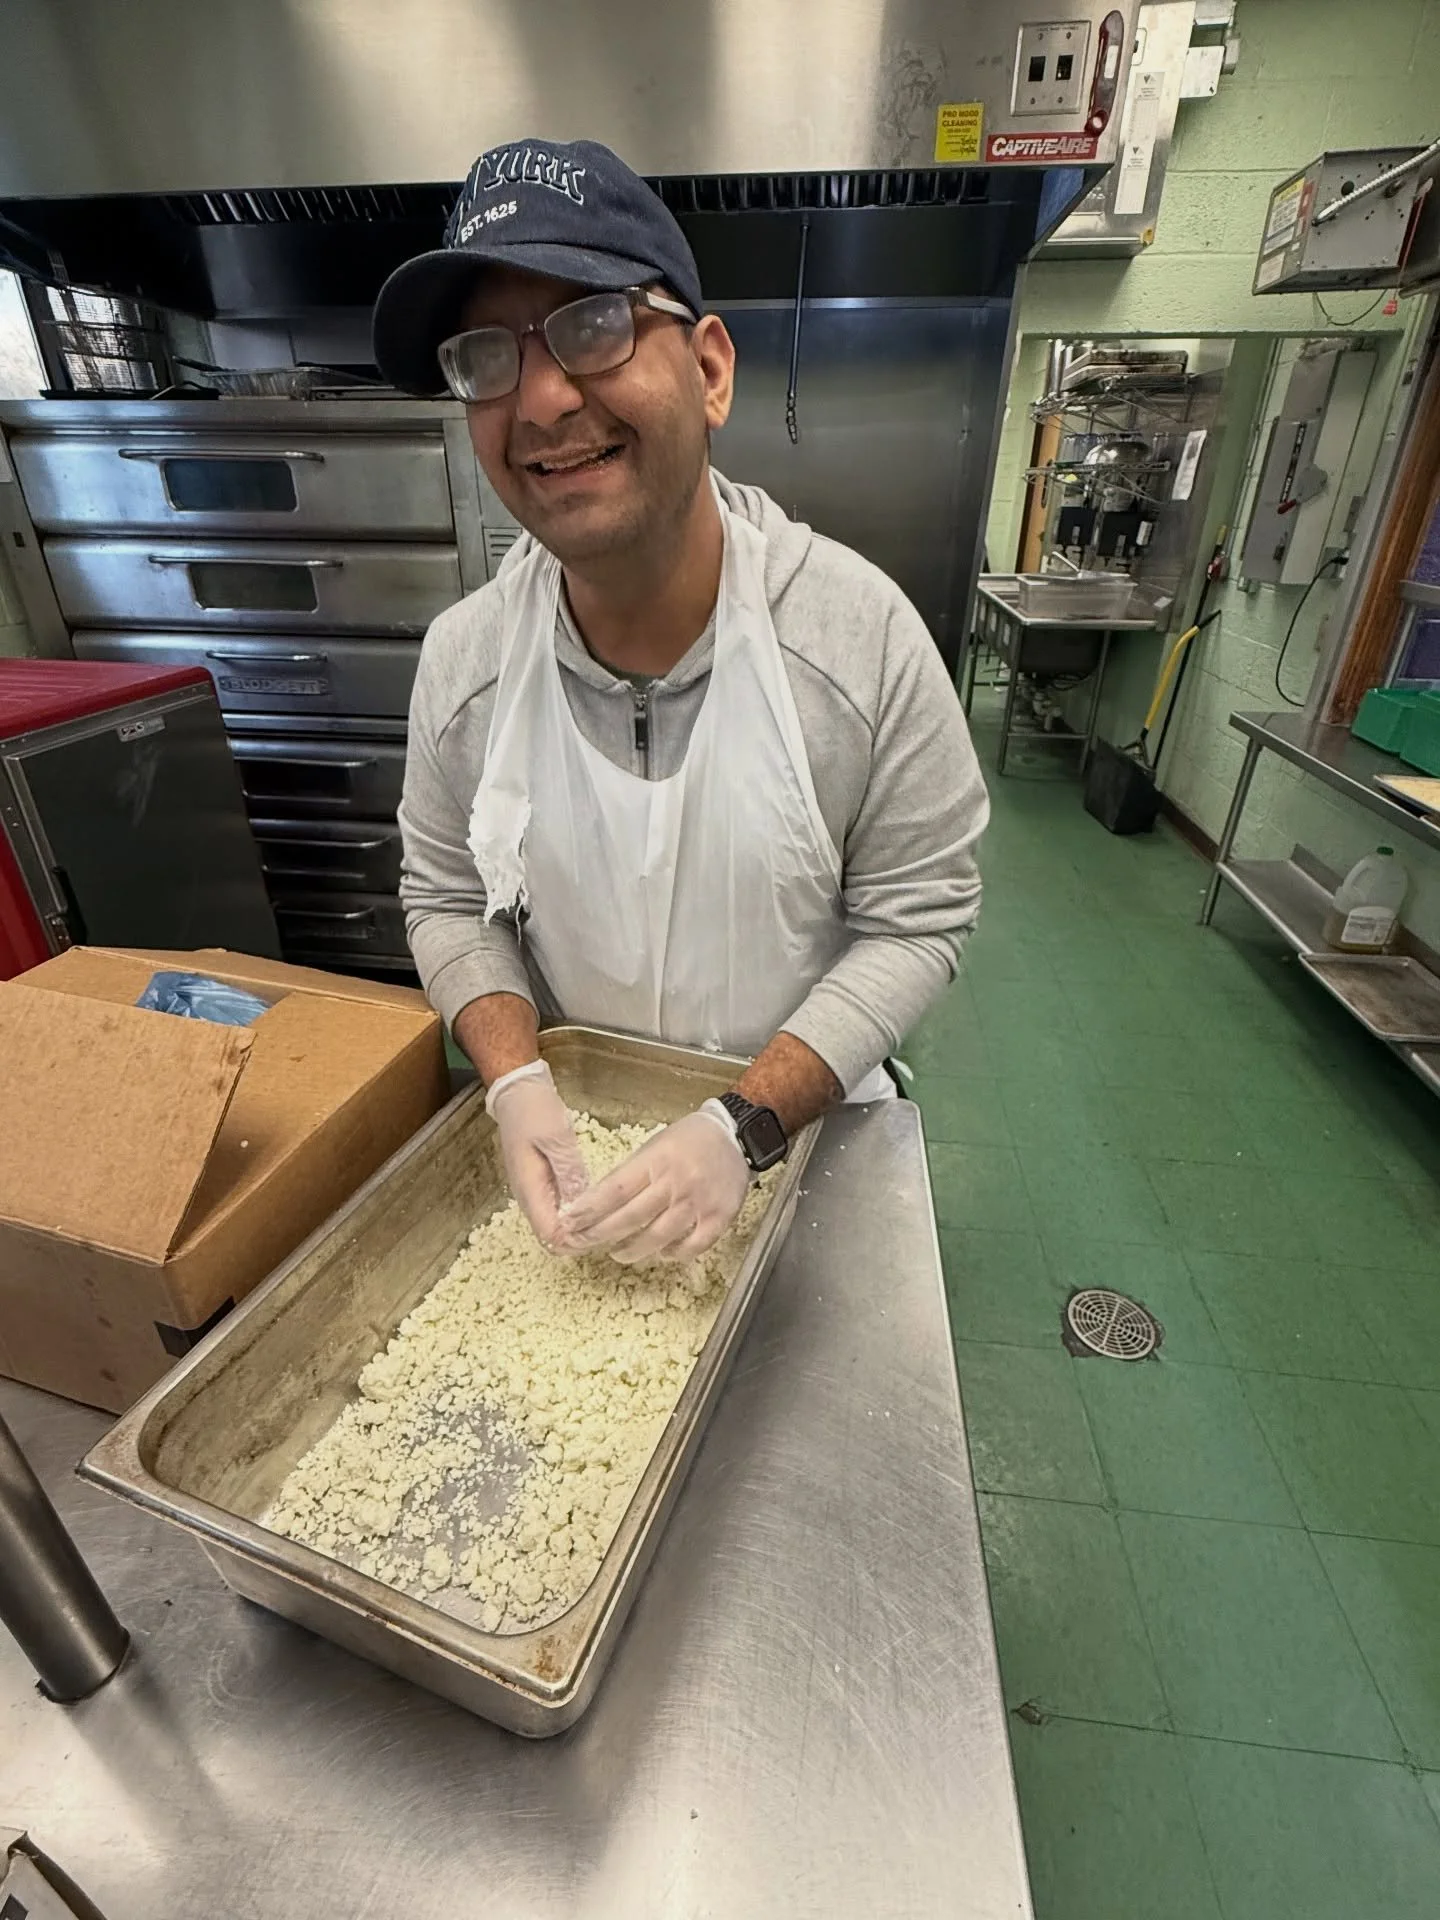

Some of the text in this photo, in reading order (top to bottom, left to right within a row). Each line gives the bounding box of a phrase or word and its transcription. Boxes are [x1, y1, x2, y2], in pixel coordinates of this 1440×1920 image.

[942, 110, 957, 118] PRO
[942, 119, 978, 127] CLEANING
[461, 200, 518, 243] EST. 1625
